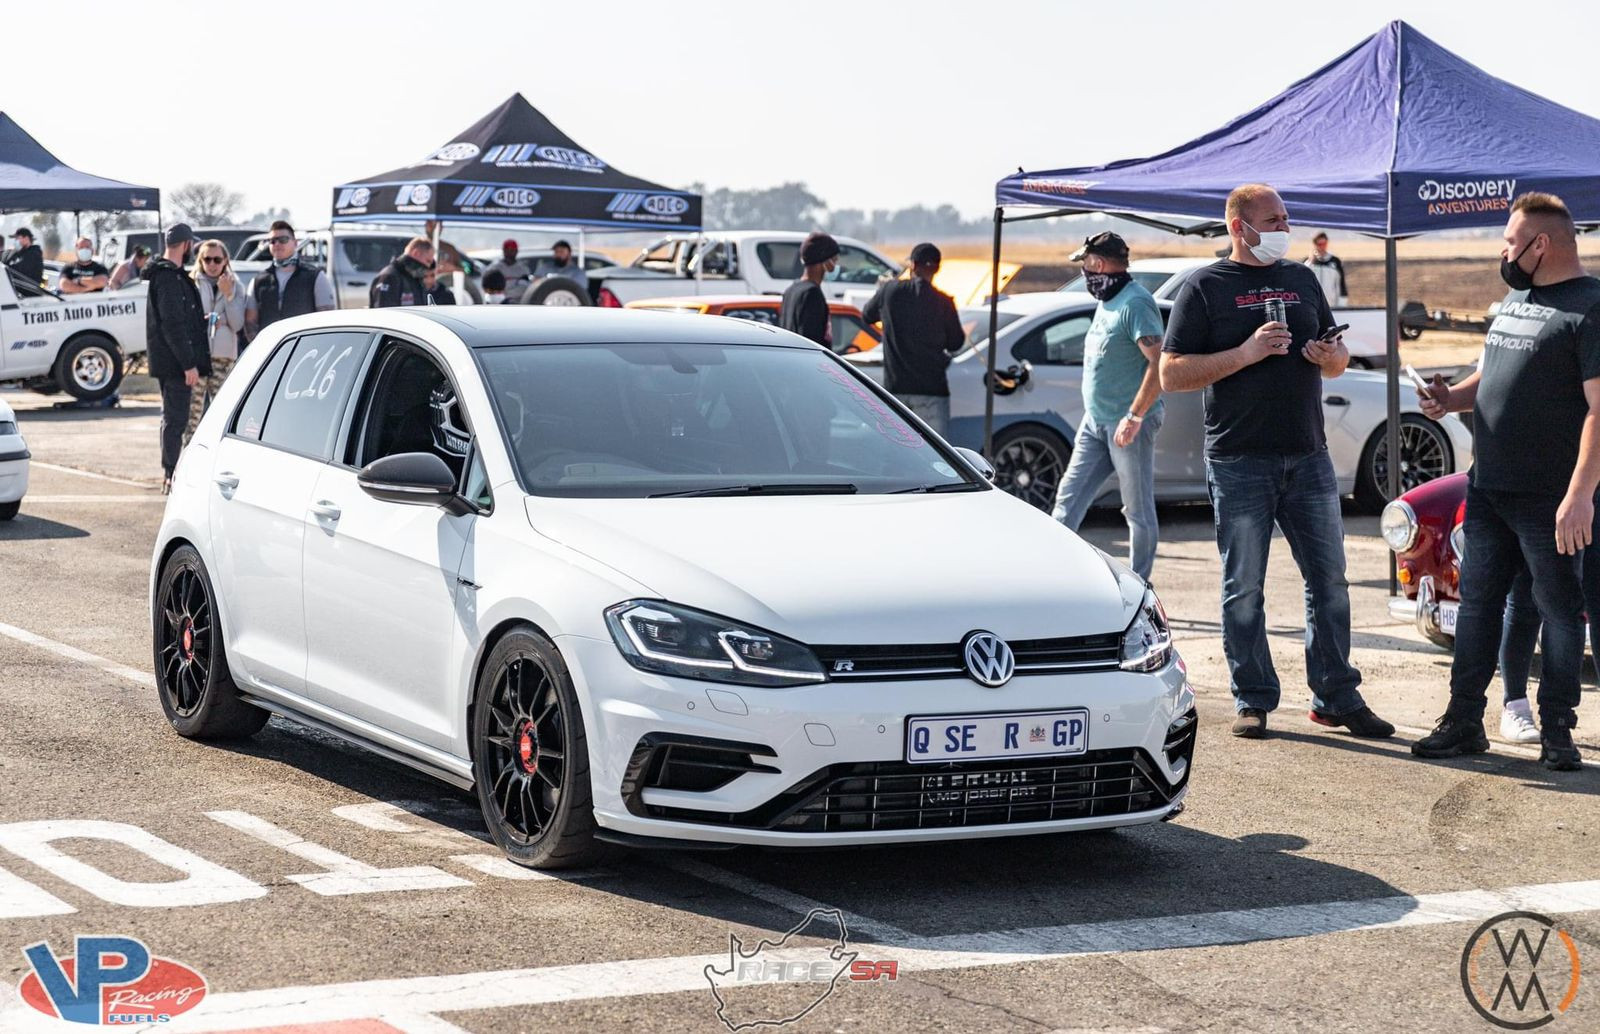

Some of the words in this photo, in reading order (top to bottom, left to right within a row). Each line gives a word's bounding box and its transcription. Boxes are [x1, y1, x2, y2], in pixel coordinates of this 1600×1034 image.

[1422, 179, 1516, 201] Discovery
[1427, 197, 1508, 215] ADVENTURES
[22, 310, 59, 325] Trans
[64, 306, 93, 321] Auto
[97, 301, 137, 318] Diesel
[1501, 301, 1557, 320] UNDER
[284, 344, 353, 400] C16
[1442, 608, 1458, 626] HB
[914, 727, 930, 754] Q
[945, 725, 977, 753] SE
[1004, 722, 1019, 750] R
[1052, 719, 1083, 747] GP
